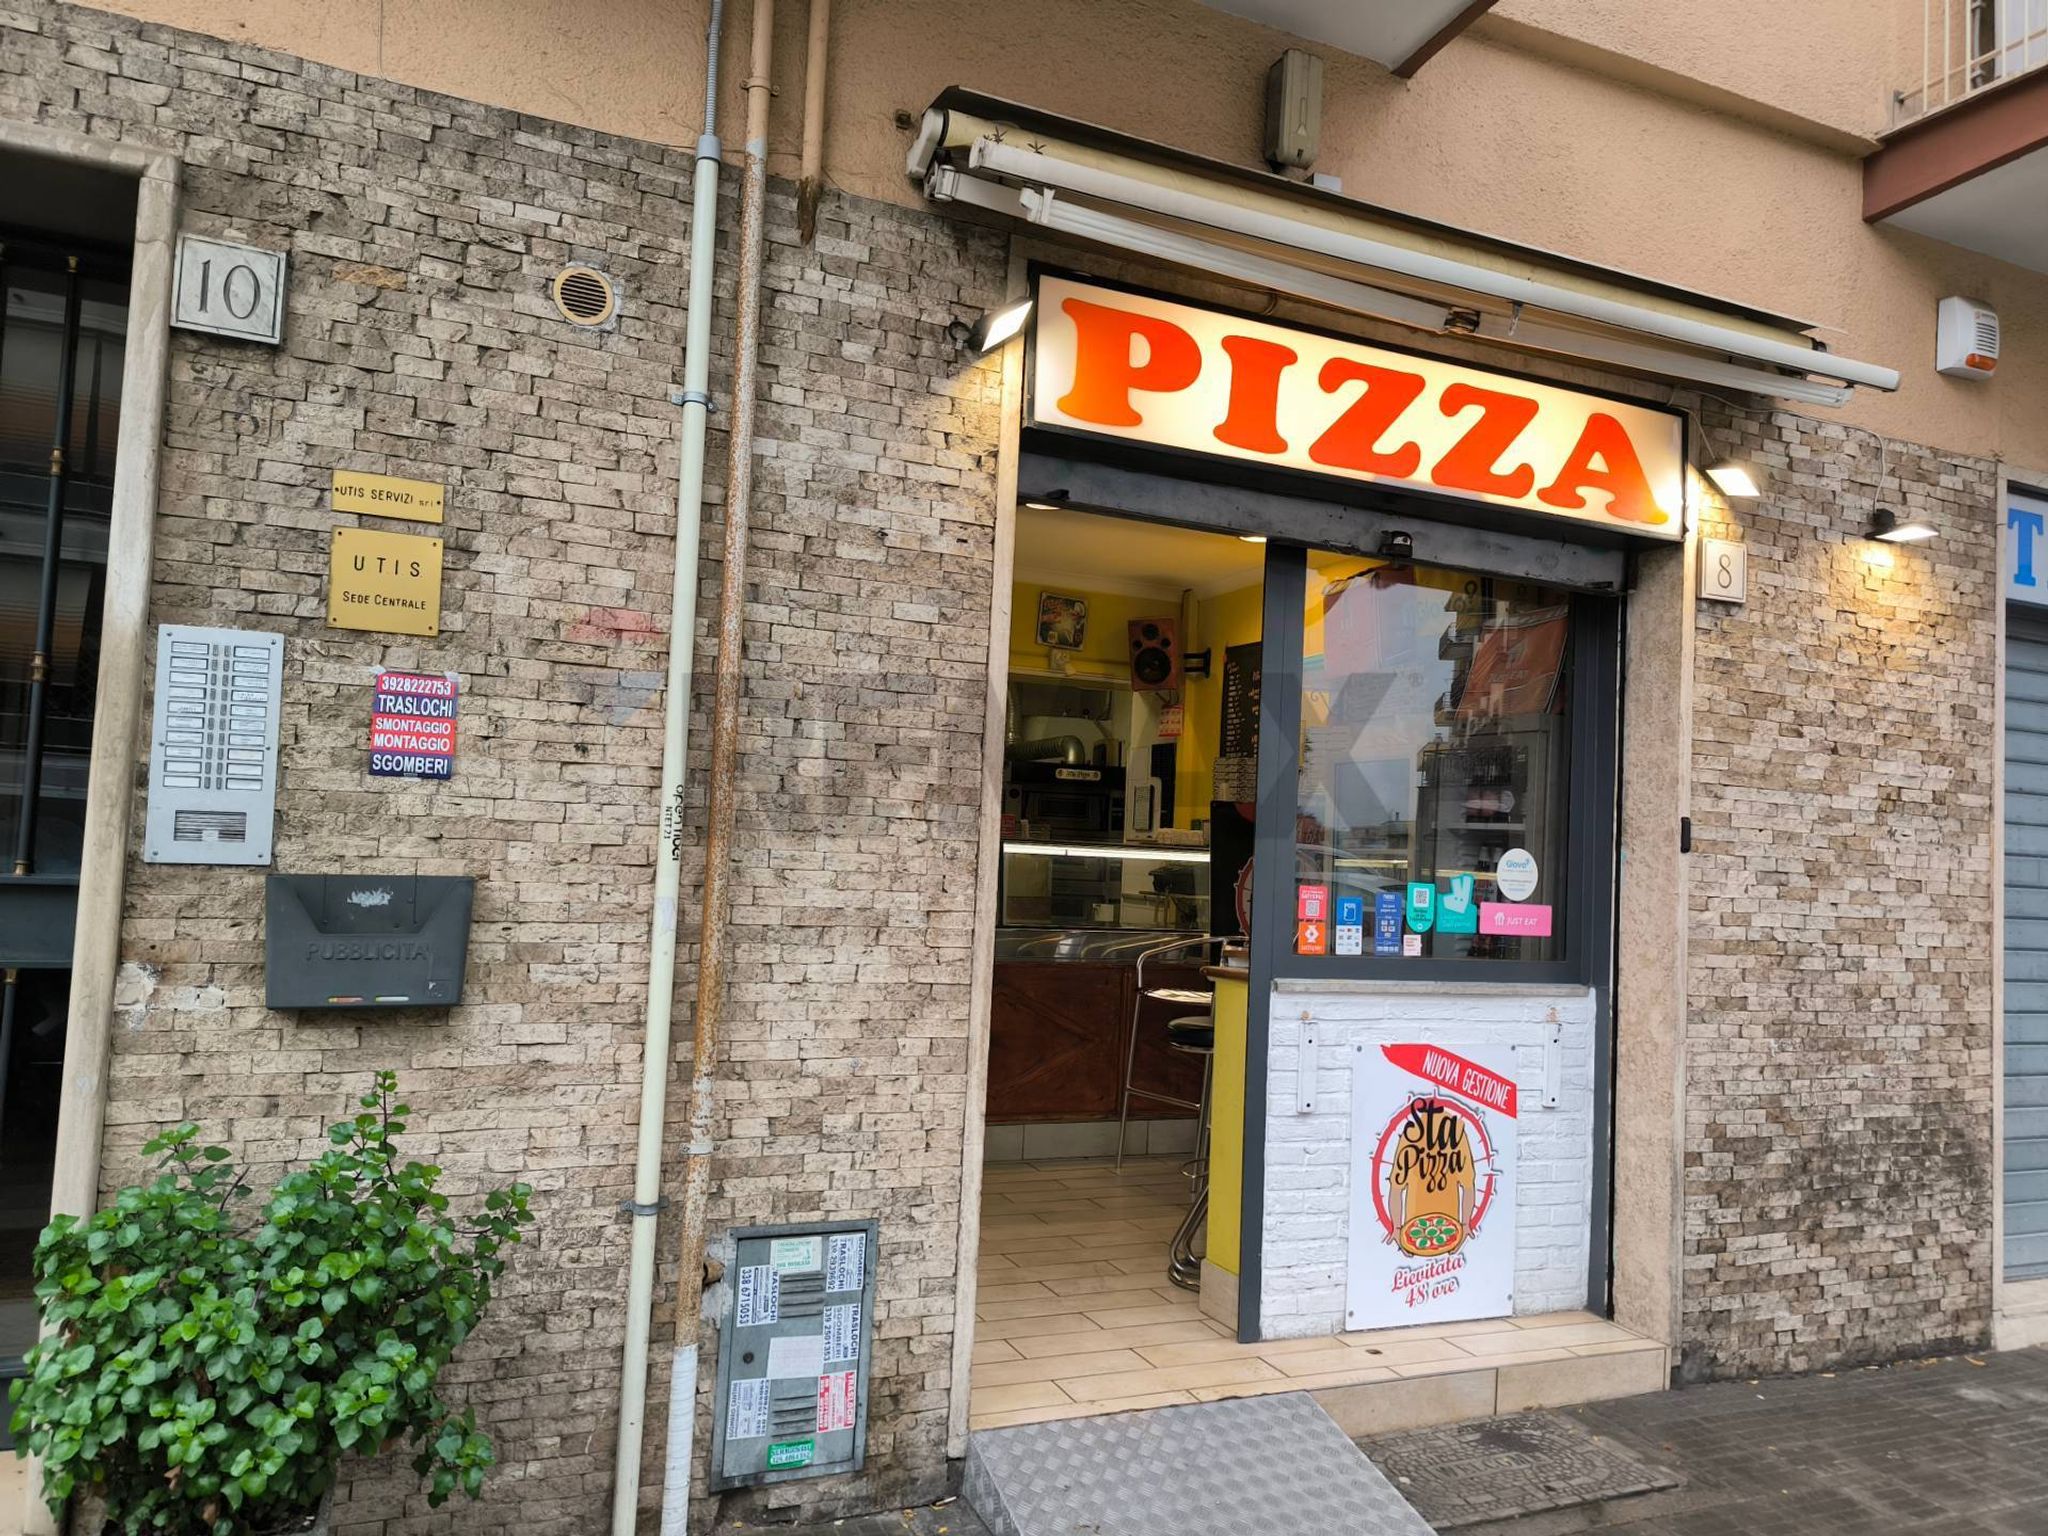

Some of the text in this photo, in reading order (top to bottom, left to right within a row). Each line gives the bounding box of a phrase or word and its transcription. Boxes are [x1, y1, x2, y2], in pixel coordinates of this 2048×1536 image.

[197, 258, 262, 320] 10
[1057, 296, 1668, 526] PIZZA
[340, 486, 365, 499] UTIS
[371, 489, 413, 505] SERVIZI
[2008, 508, 2048, 588] T
[1717, 553, 1732, 589] 8
[381, 676, 452, 696] 3928222753
[378, 694, 453, 718] TRASLOCHI
[373, 733, 450, 752] MONTAGGIO
[375, 717, 451, 735] SMONTAGGIO
[372, 754, 448, 775] SGOMBERI
[1421, 1049, 1511, 1109] NUOVA GESTIONE
[1403, 1098, 1465, 1150] Sta
[1395, 1144, 1467, 1193] Pizza
[741, 1269, 752, 1285] 338
[838, 1239, 847, 1290] TRASLOCHI
[1391, 1256, 1463, 1292] Lievitata
[770, 1267, 778, 1321] RASLOCHI
[1432, 1280, 1455, 1298] ore
[850, 1304, 859, 1358] TRASLOCHI
